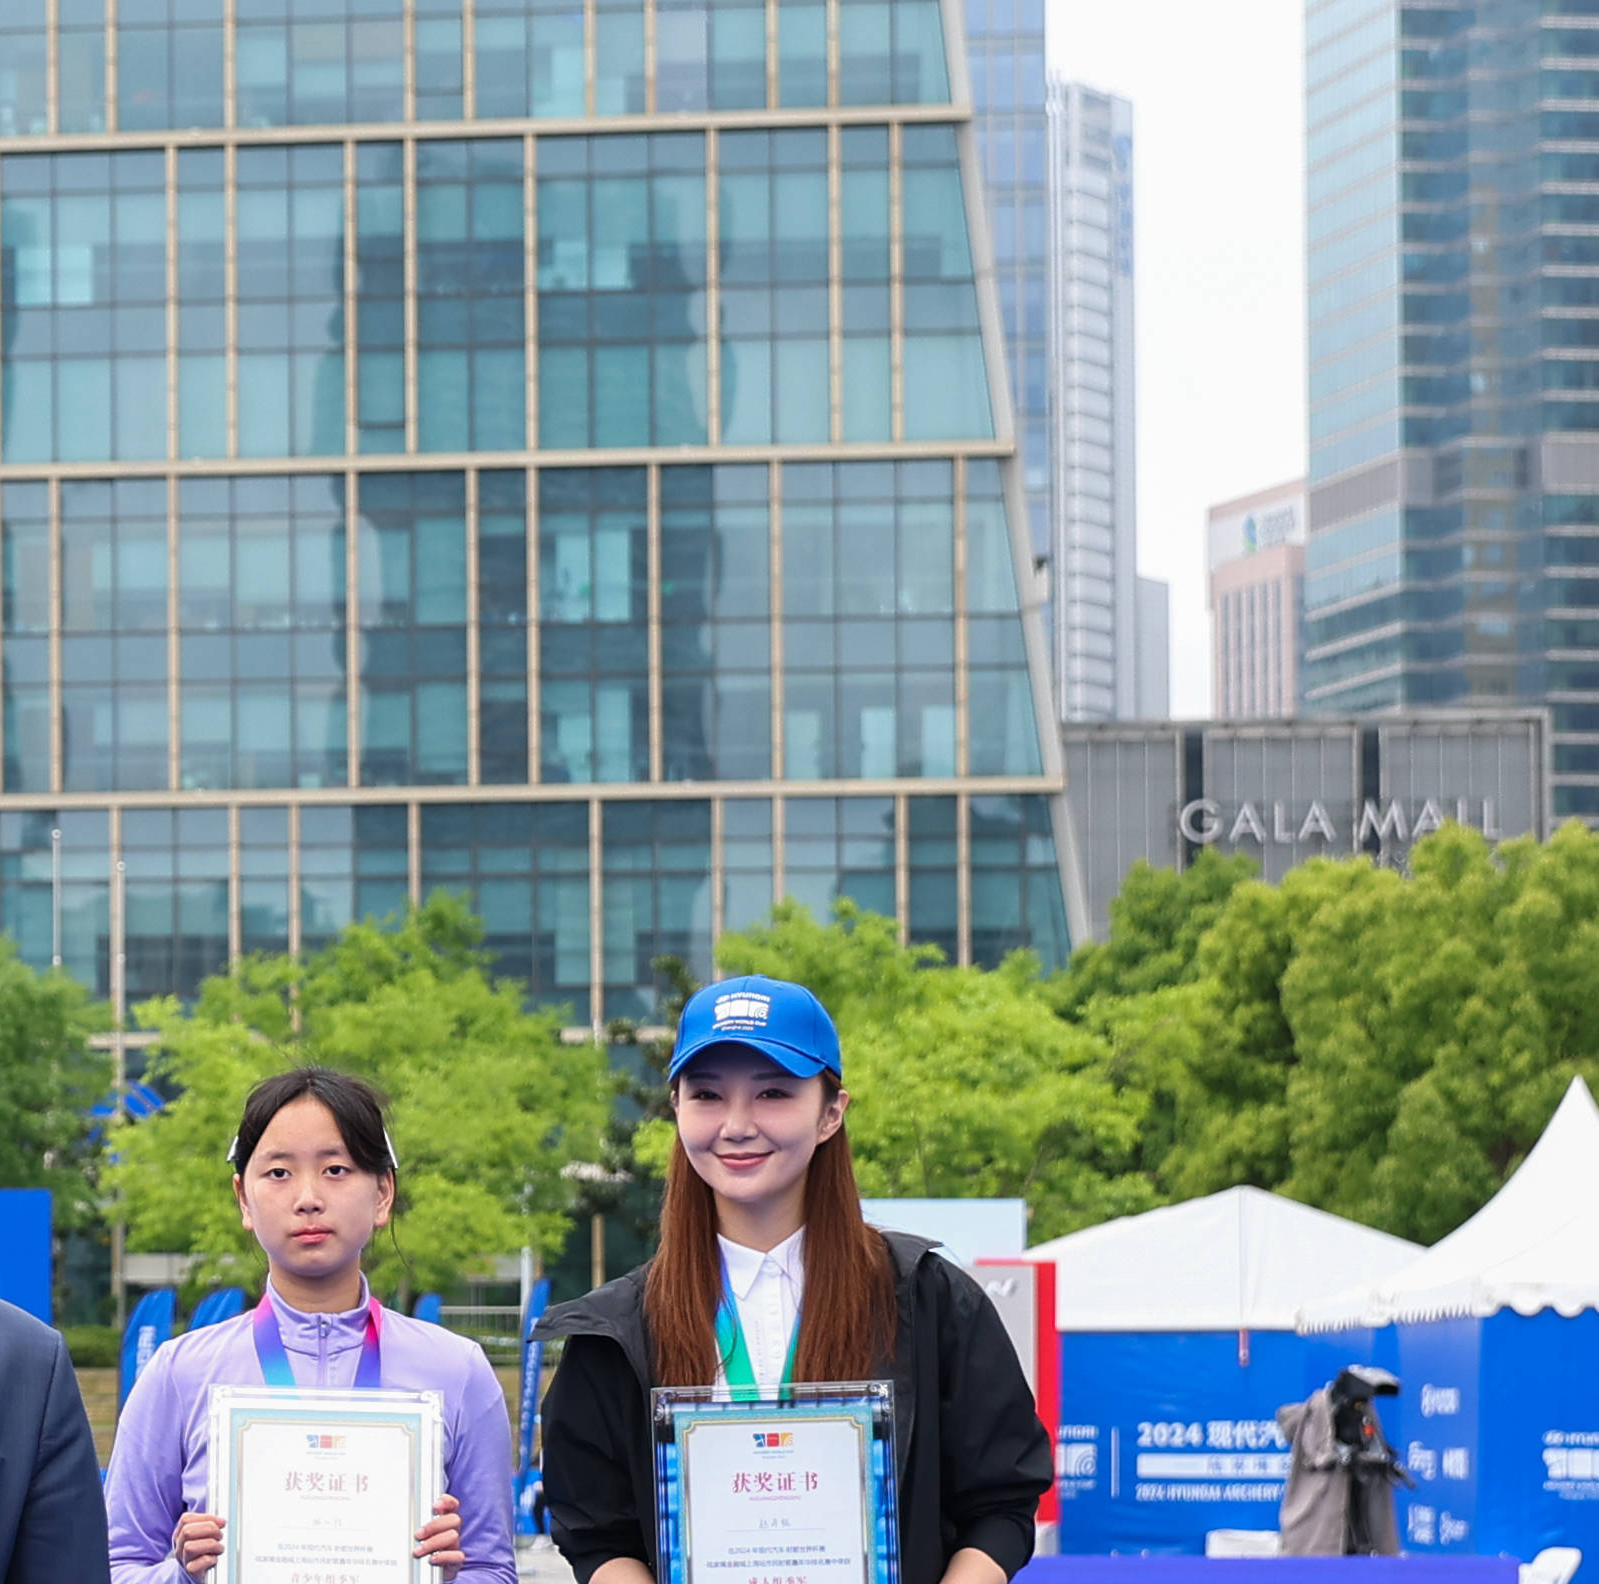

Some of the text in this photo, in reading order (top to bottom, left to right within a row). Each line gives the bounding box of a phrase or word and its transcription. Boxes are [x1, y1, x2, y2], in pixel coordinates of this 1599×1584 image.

[1180, 799, 1502, 843] GALA MALL
[1137, 1421, 1201, 1448] 2024
[285, 1472, 369, 1494] 获奖证书
[732, 1471, 819, 1493] 获奖证书
[1166, 1484, 1221, 1501] HYUNDAI
